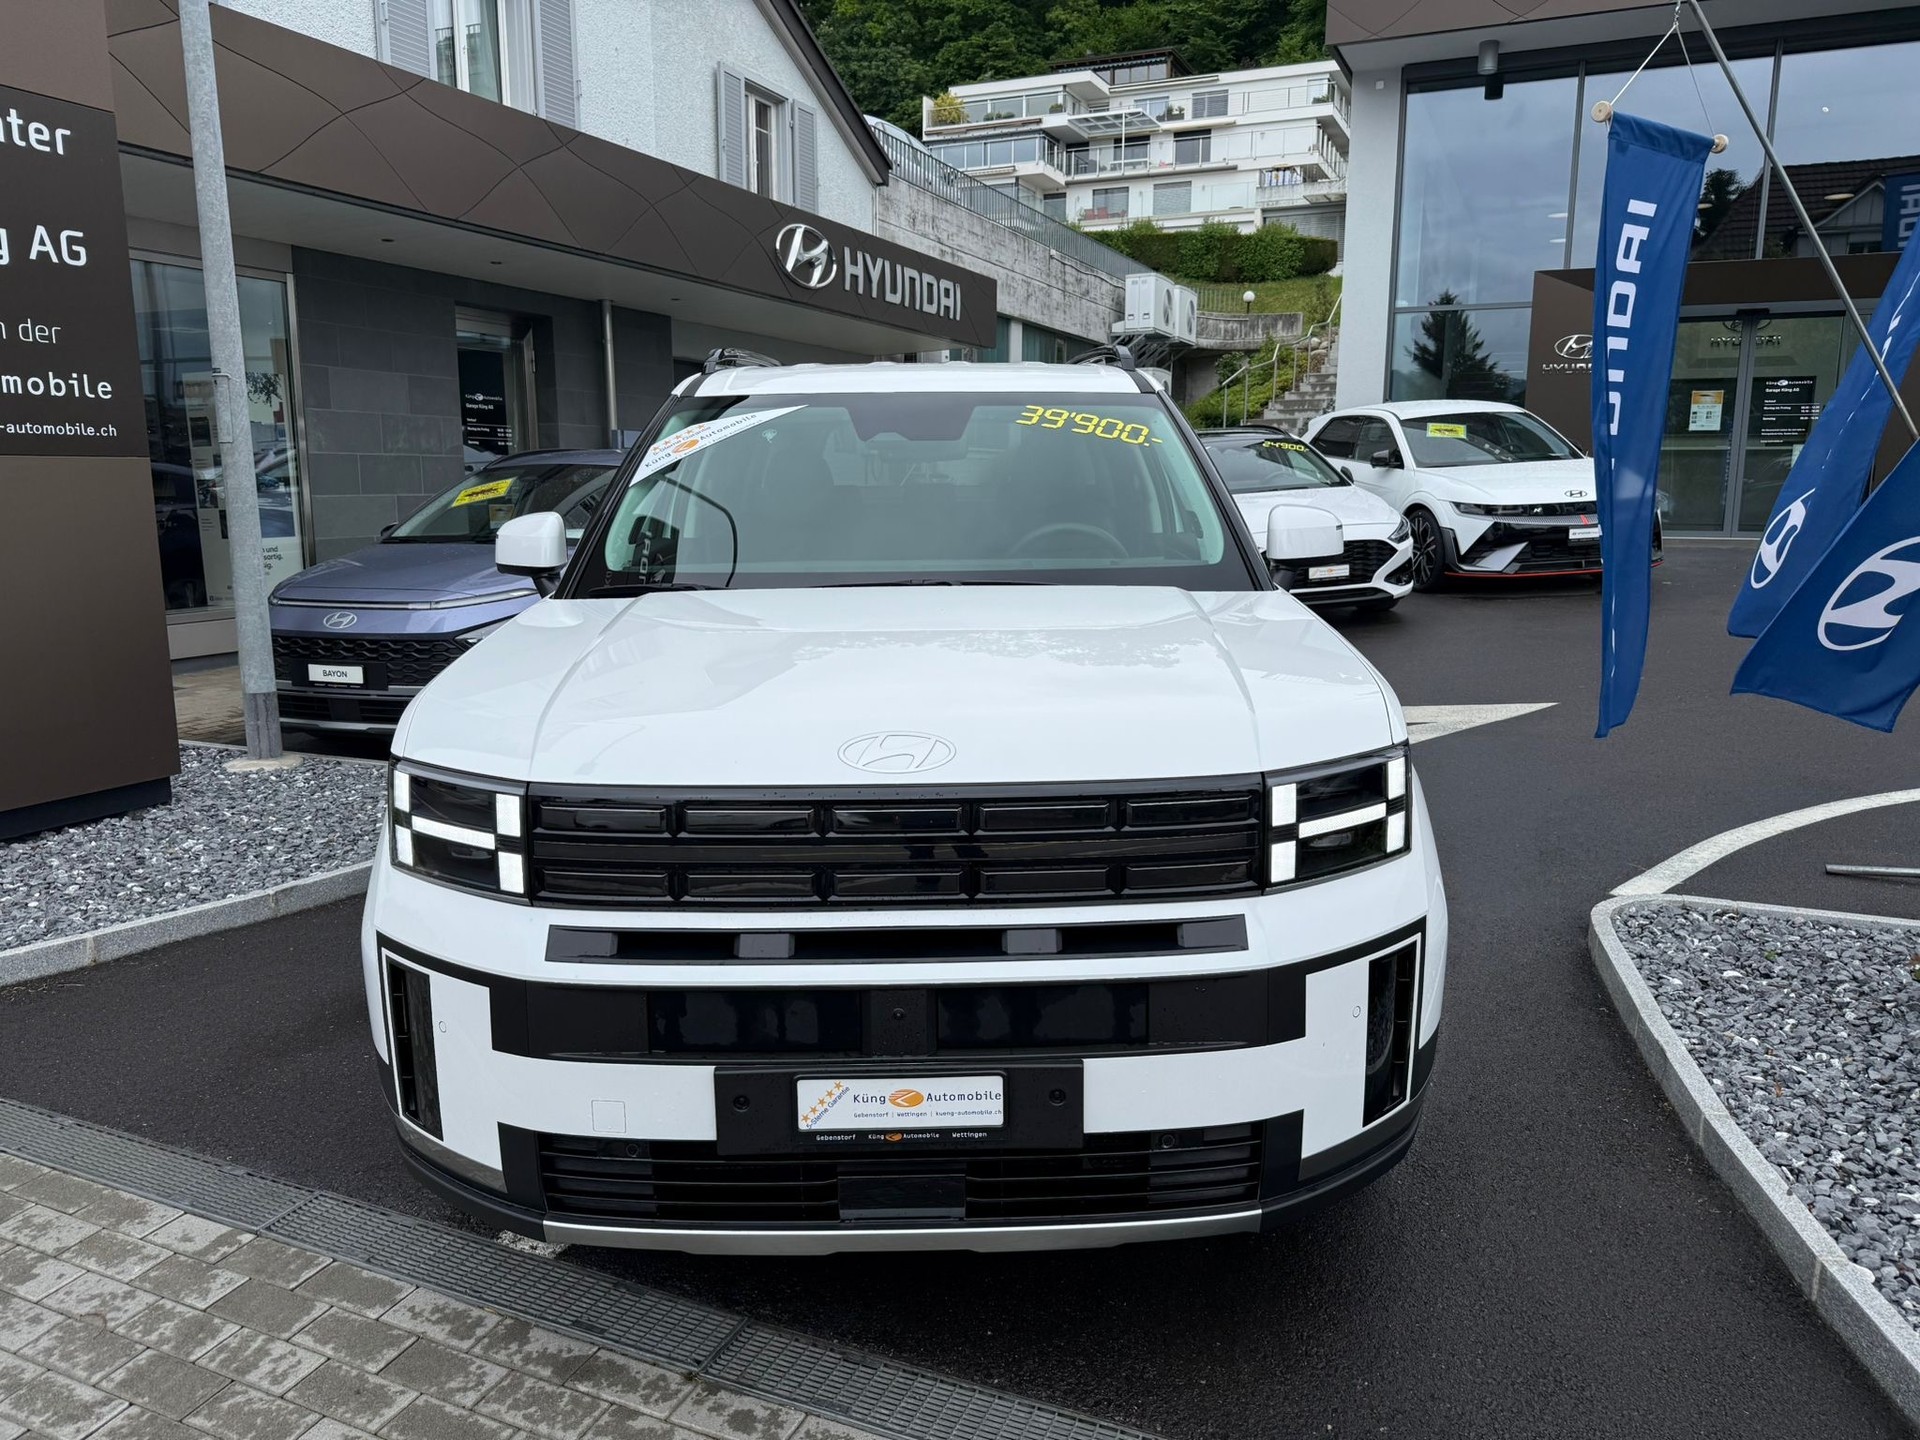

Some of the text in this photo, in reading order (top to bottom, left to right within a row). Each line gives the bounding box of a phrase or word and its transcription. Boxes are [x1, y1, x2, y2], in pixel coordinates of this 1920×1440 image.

[0, 108, 71, 155] ter
[29, 224, 87, 267] AG
[843, 246, 961, 321] HYUNDAI
[18, 318, 61, 344] der
[1, 371, 112, 399] mobile
[699, 414, 757, 441] Automobile
[1016, 404, 1163, 447] 39'900.-
[322, 669, 348, 678] BAYON
[828, 1086, 850, 1109] Garantie
[853, 1090, 1002, 1105] Küng Automobile
[935, 1109, 1002, 1117] kueng-automobile.ch
